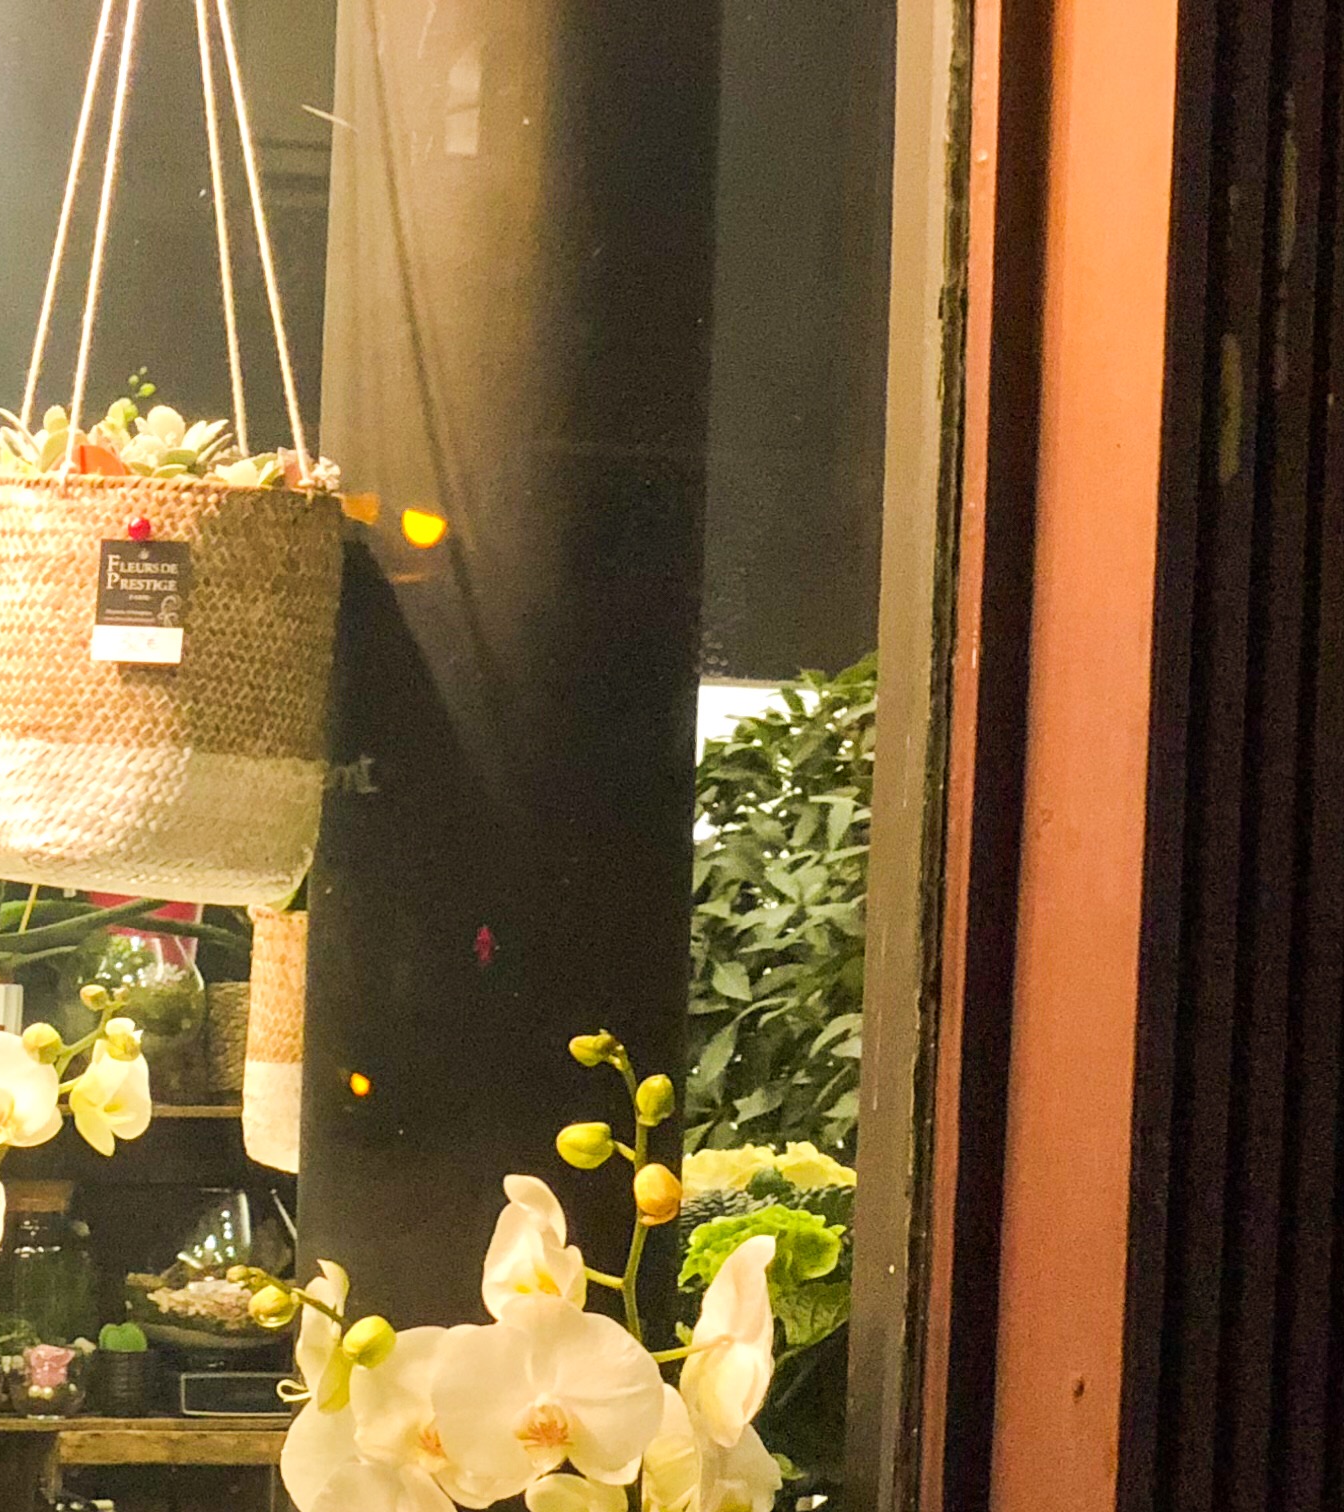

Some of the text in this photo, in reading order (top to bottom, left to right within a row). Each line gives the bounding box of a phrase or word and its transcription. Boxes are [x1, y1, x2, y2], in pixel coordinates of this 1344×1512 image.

[107, 554, 179, 575] FLEURS DE
[105, 572, 178, 591] PRESTIGE
